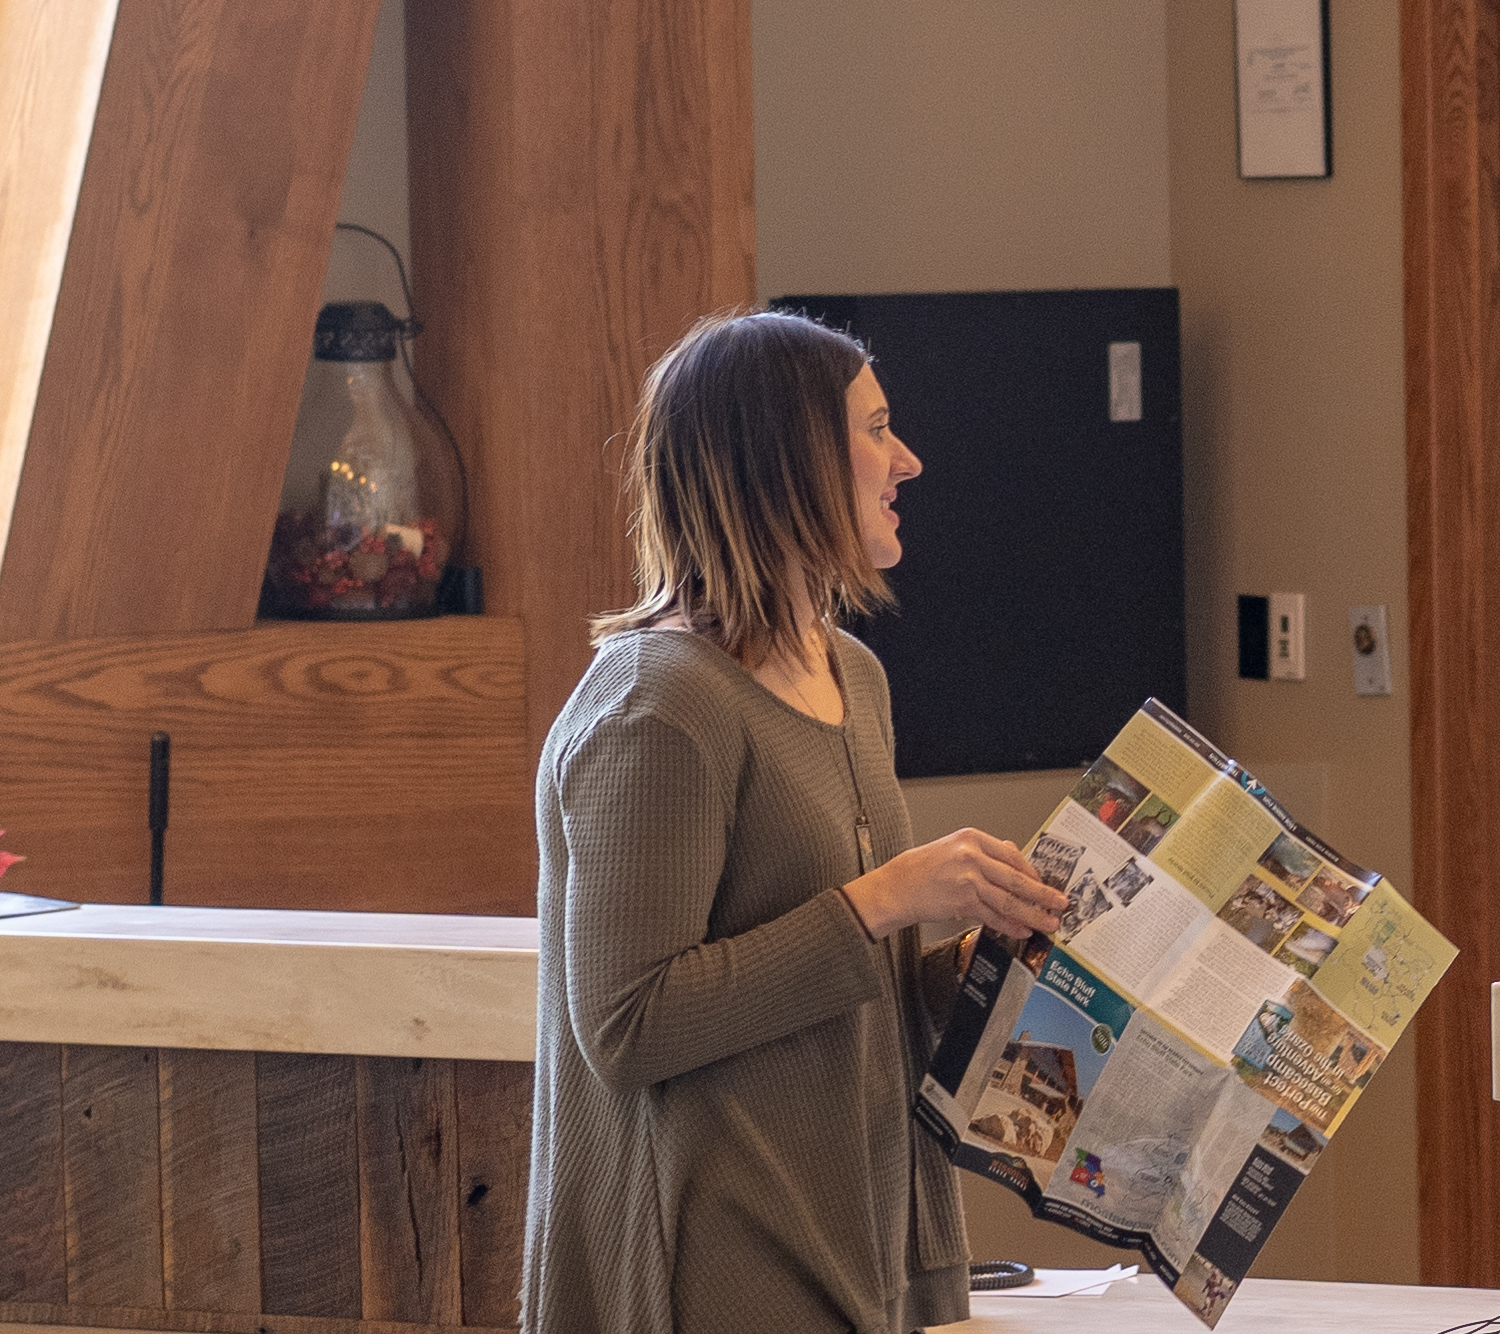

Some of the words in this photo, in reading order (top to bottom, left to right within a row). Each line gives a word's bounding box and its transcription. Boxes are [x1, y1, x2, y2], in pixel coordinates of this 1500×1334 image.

[1044, 970, 1071, 992] State
[1069, 986, 1091, 1008] Park
[1049, 960, 1075, 982] Echo
[1073, 976, 1096, 998] Bluff
[1266, 1031, 1324, 1082] Adventure
[1262, 1071, 1314, 1111] Perfect
[1266, 1053, 1332, 1107] Basecamp
[1308, 1102, 1328, 1120] The
